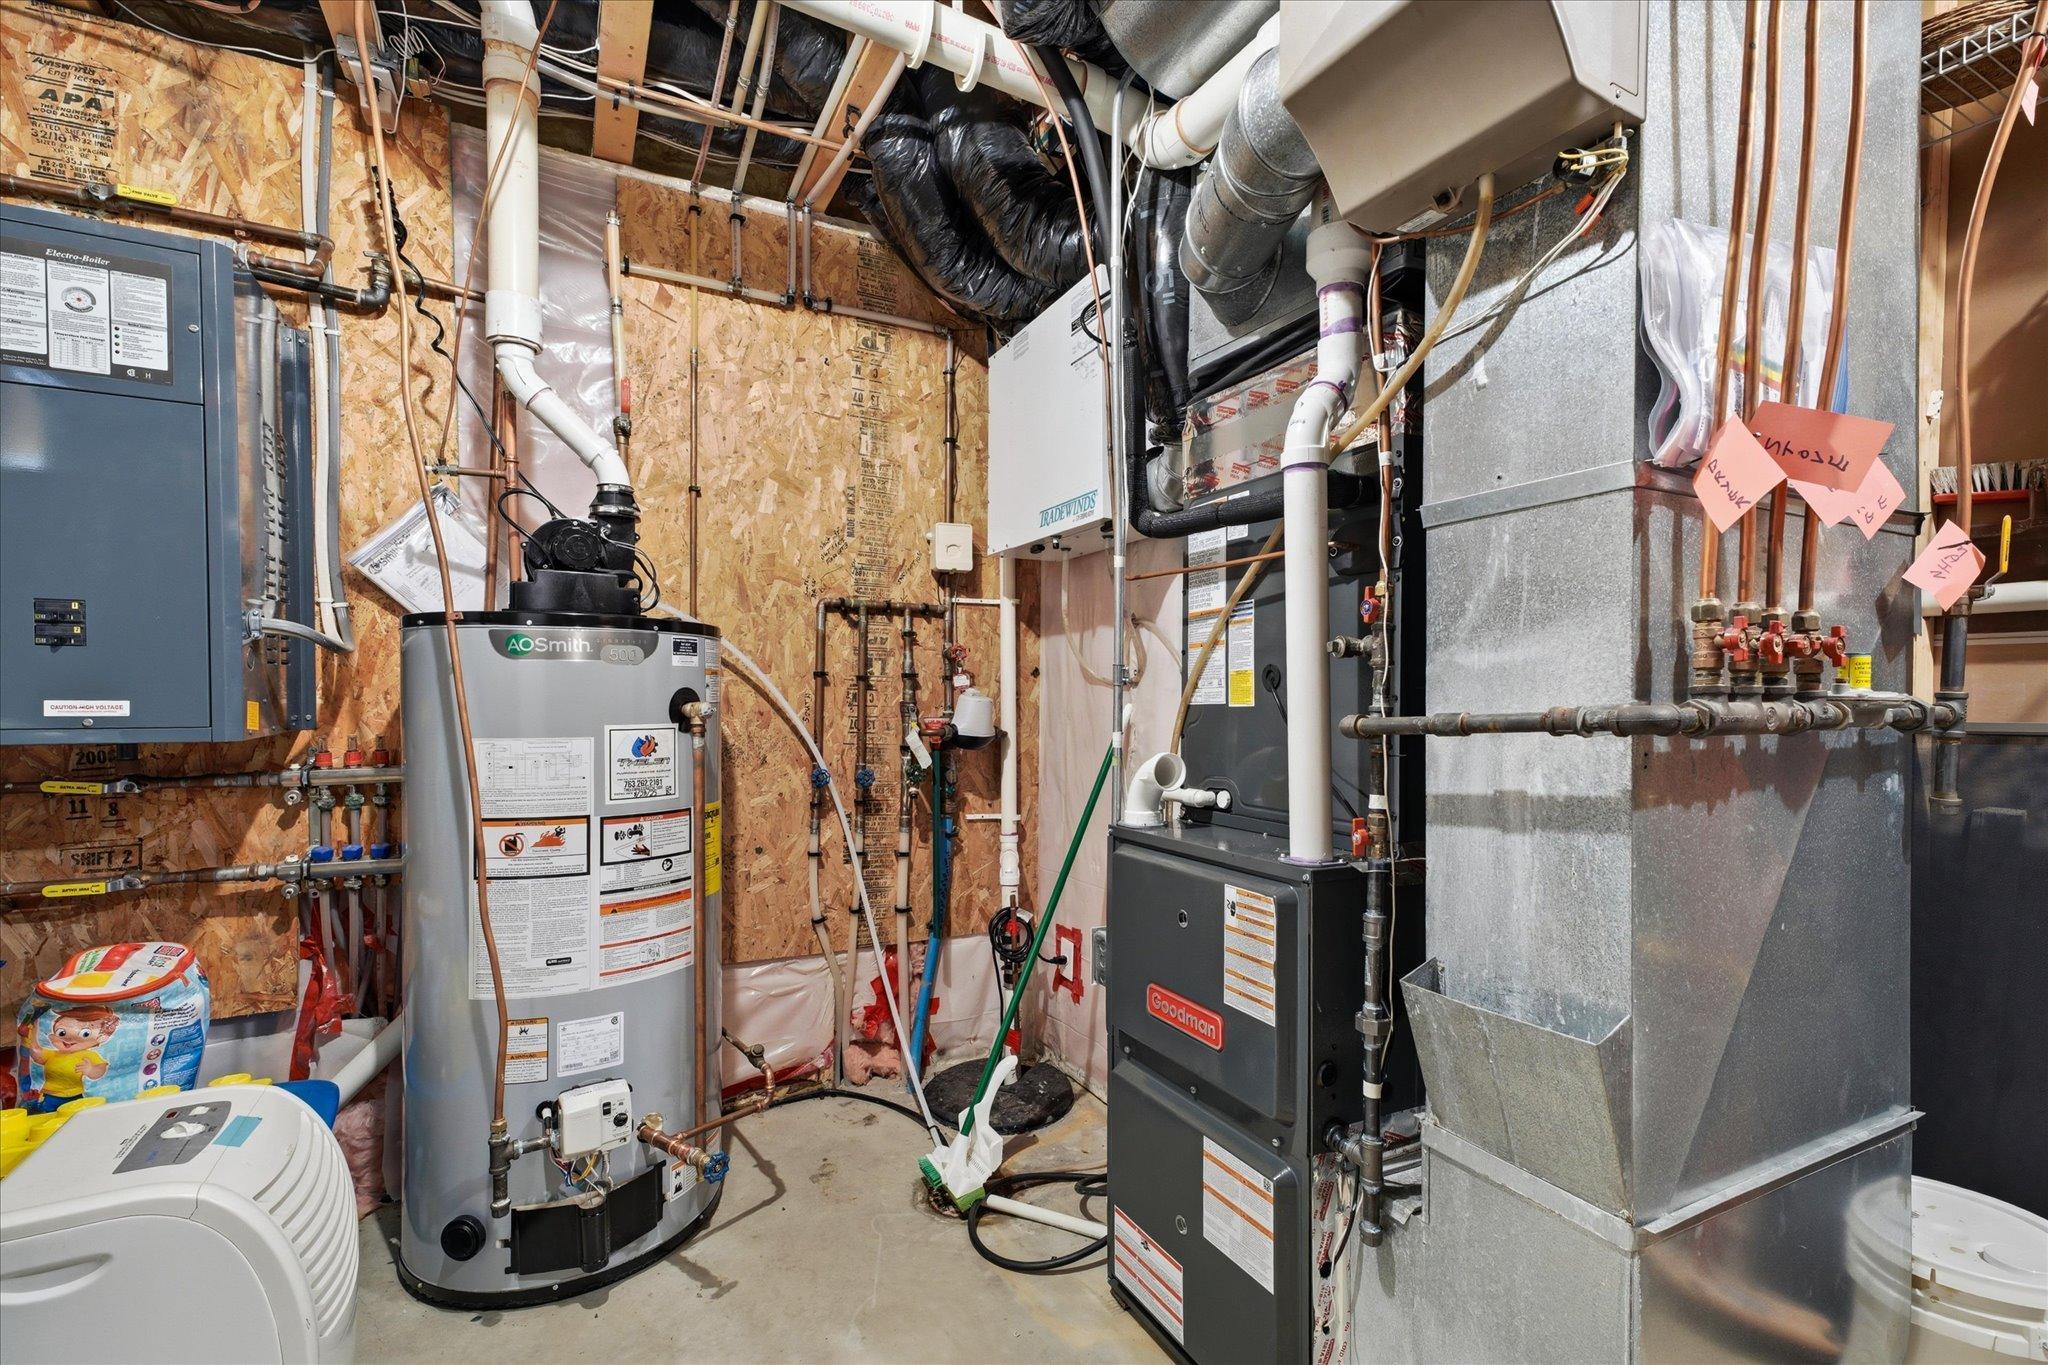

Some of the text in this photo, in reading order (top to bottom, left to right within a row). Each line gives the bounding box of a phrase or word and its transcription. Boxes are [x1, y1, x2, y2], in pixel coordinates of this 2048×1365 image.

[32, 106, 58, 116] WOOD
[38, 88, 103, 112] APA
[45, 248, 111, 266] Electro-Boiler
[1764, 437, 1849, 472] STOVE
[1707, 458, 1751, 509] DRYER
[1039, 489, 1098, 528] TRADEWINDS
[846, 518, 856, 538] MADE
[68, 798, 89, 815] 11
[70, 849, 133, 867] SHIFT 2
[1151, 992, 1216, 1040] Goodman
